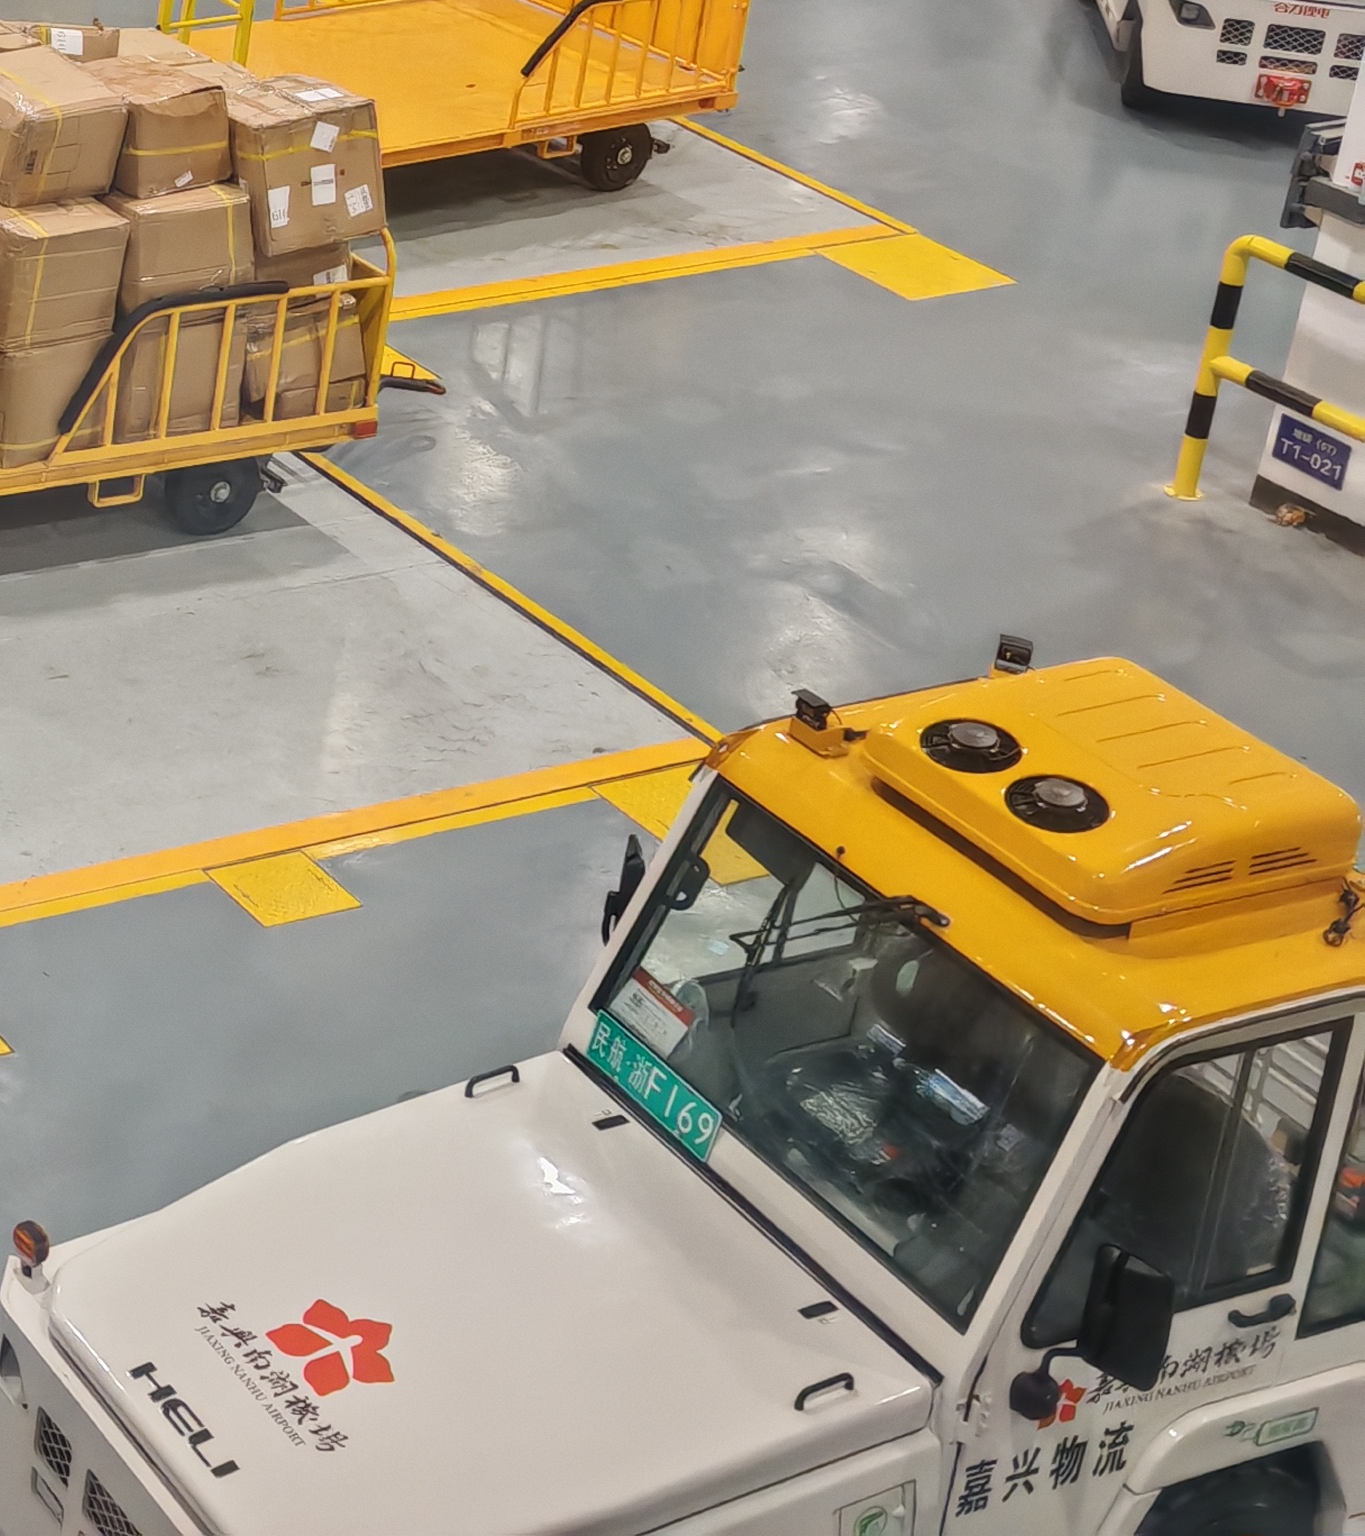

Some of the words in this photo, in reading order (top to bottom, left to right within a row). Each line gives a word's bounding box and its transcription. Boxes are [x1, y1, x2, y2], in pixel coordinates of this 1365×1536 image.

[1280, 437, 1342, 480] T1-021
[126, 1361, 241, 1479] HELI
[195, 1325, 235, 1366] JIAXING
[230, 1365, 268, 1402] NANHU
[262, 1402, 307, 1449] AIRPORT
[955, 1420, 1135, 1518] 嘉兴物流
